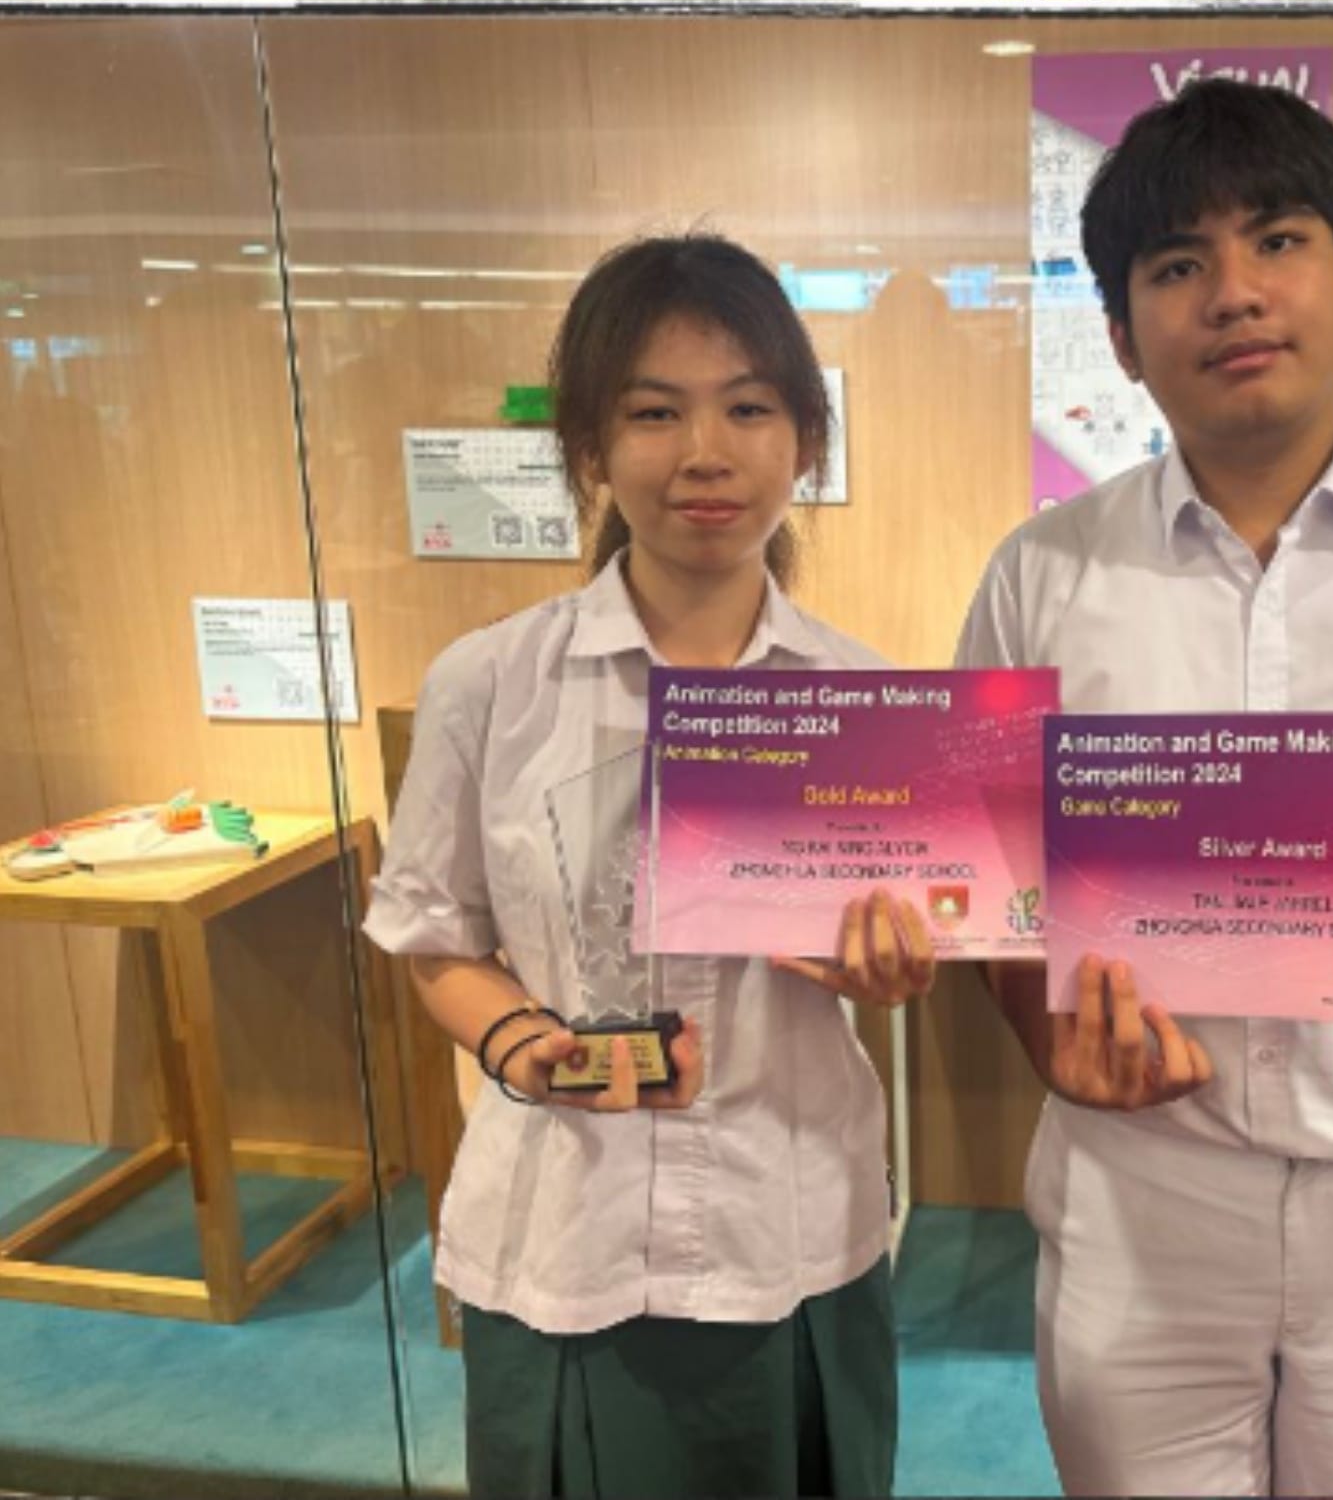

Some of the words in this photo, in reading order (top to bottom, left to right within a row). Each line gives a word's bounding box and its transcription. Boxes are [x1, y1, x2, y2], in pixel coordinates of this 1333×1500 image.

[664, 683, 767, 706] Animation
[774, 684, 812, 706] and
[818, 685, 873, 707] Game
[881, 686, 951, 709] Making
[662, 713, 788, 737] Competition
[792, 715, 840, 736] 2024
[664, 745, 738, 762] Animation
[1057, 731, 1165, 755] Animation
[1172, 731, 1211, 754] and
[1217, 731, 1280, 755] Game
[1057, 762, 1186, 788] Competition
[1190, 763, 1242, 784] 2024
[803, 784, 847, 806] Gold
[852, 784, 910, 806] Award
[1060, 797, 1106, 816] Game
[1109, 797, 1181, 819] Category
[1198, 837, 1256, 859] Silver
[1261, 837, 1328, 859] Award
